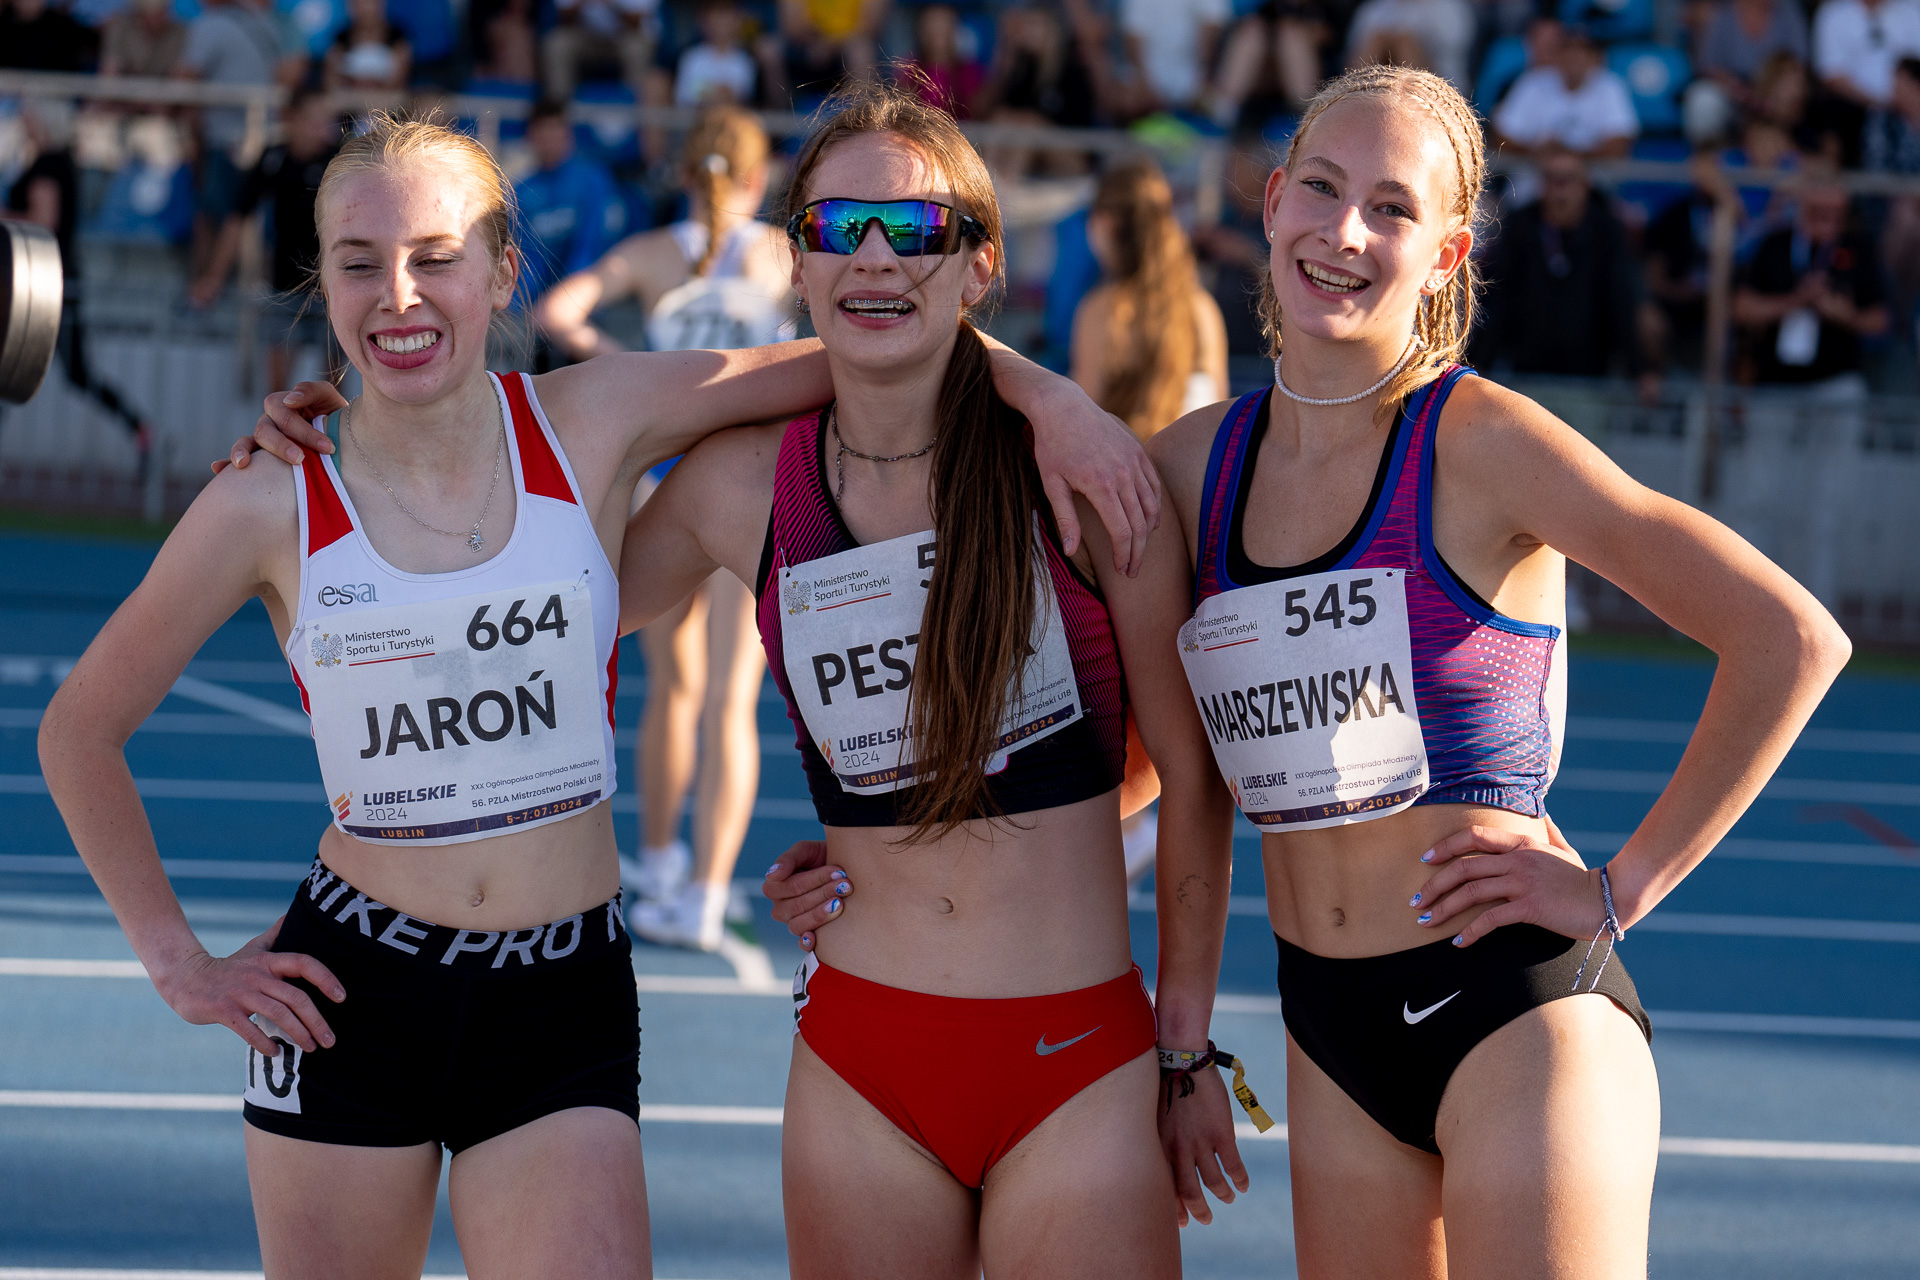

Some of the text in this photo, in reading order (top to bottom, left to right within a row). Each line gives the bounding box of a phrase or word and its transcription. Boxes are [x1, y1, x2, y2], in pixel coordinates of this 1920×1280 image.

[814, 569, 869, 589] Ministerstwo
[814, 588, 843, 602] Sportu
[849, 575, 891, 592] Turystyki
[1285, 578, 1377, 637] 545
[466, 594, 569, 651] 664
[1198, 613, 1239, 629] Ministerstwo
[1199, 629, 1219, 642] Sportu
[1223, 620, 1258, 636] Turystyki
[345, 628, 411, 643] Ministerstwo
[346, 643, 380, 657] Sportu
[388, 635, 435, 651] Turystyki
[1032, 695, 1057, 713] Polski
[1057, 688, 1072, 701] U18
[1200, 662, 1406, 745] MARSZEWSKA
[360, 669, 557, 760] JAROŃ
[839, 724, 915, 752] LUBELSKI
[843, 750, 880, 768] 2024
[1294, 754, 1418, 780] XXX Ogólnopolska Olimpiada Młodzieży
[470, 759, 600, 791] XXX Ogólnopolska Olimpiada Młodzieży
[858, 770, 898, 786] LUBLIN
[1241, 772, 1288, 790] LUBELSKIE
[1297, 768, 1422, 798] 56. PZLA Mistrzostwa Polski U18
[363, 783, 457, 806] LUBELSKIE
[472, 773, 602, 808] 56. PZLA Mistrzostwa Polski U18
[1246, 791, 1269, 806] 2024
[365, 807, 408, 821] 2024
[506, 798, 582, 825] 5-7.07.2024
[1322, 794, 1402, 816] 5-7.07.2024
[1259, 813, 1282, 823] LUBLIN
[380, 828, 425, 838] LUBLIN
[307, 859, 436, 955] NIKE
[440, 912, 583, 969] PRO
